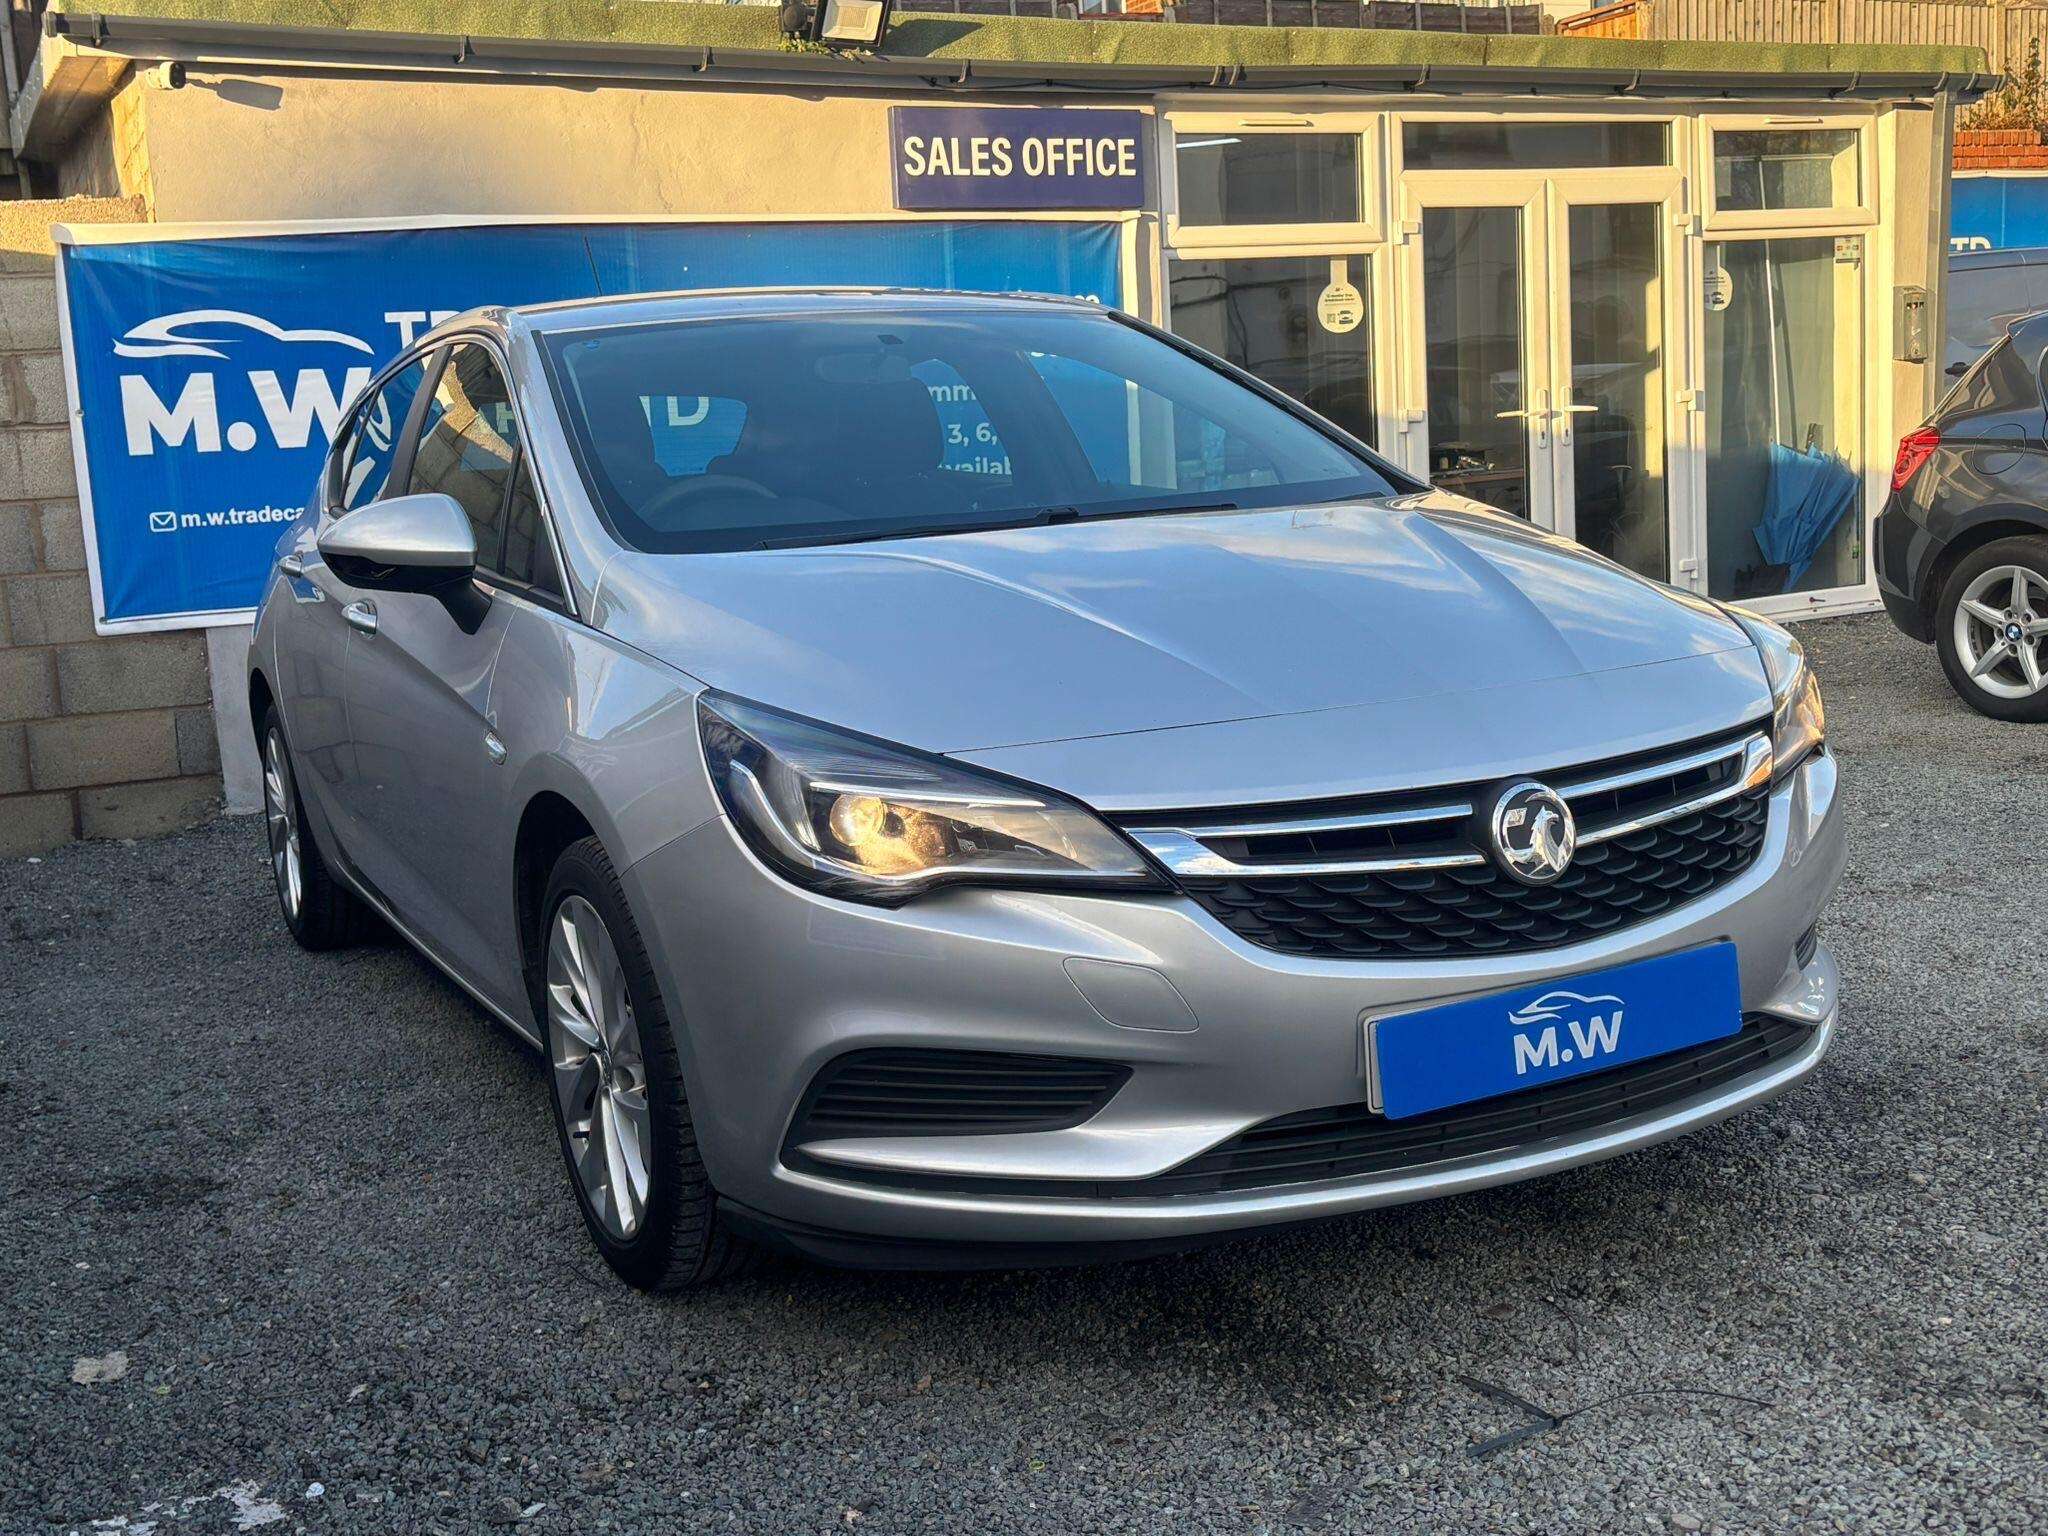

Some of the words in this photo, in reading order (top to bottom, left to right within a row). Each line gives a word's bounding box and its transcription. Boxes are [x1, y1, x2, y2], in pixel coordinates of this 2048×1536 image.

[903, 136, 1013, 177] SALES
[1022, 137, 1137, 177] OFFICE
[119, 366, 372, 456] M.W
[947, 423, 969, 447] 3,
[975, 422, 998, 446] 6,
[1512, 1010, 1624, 1075] M.W
